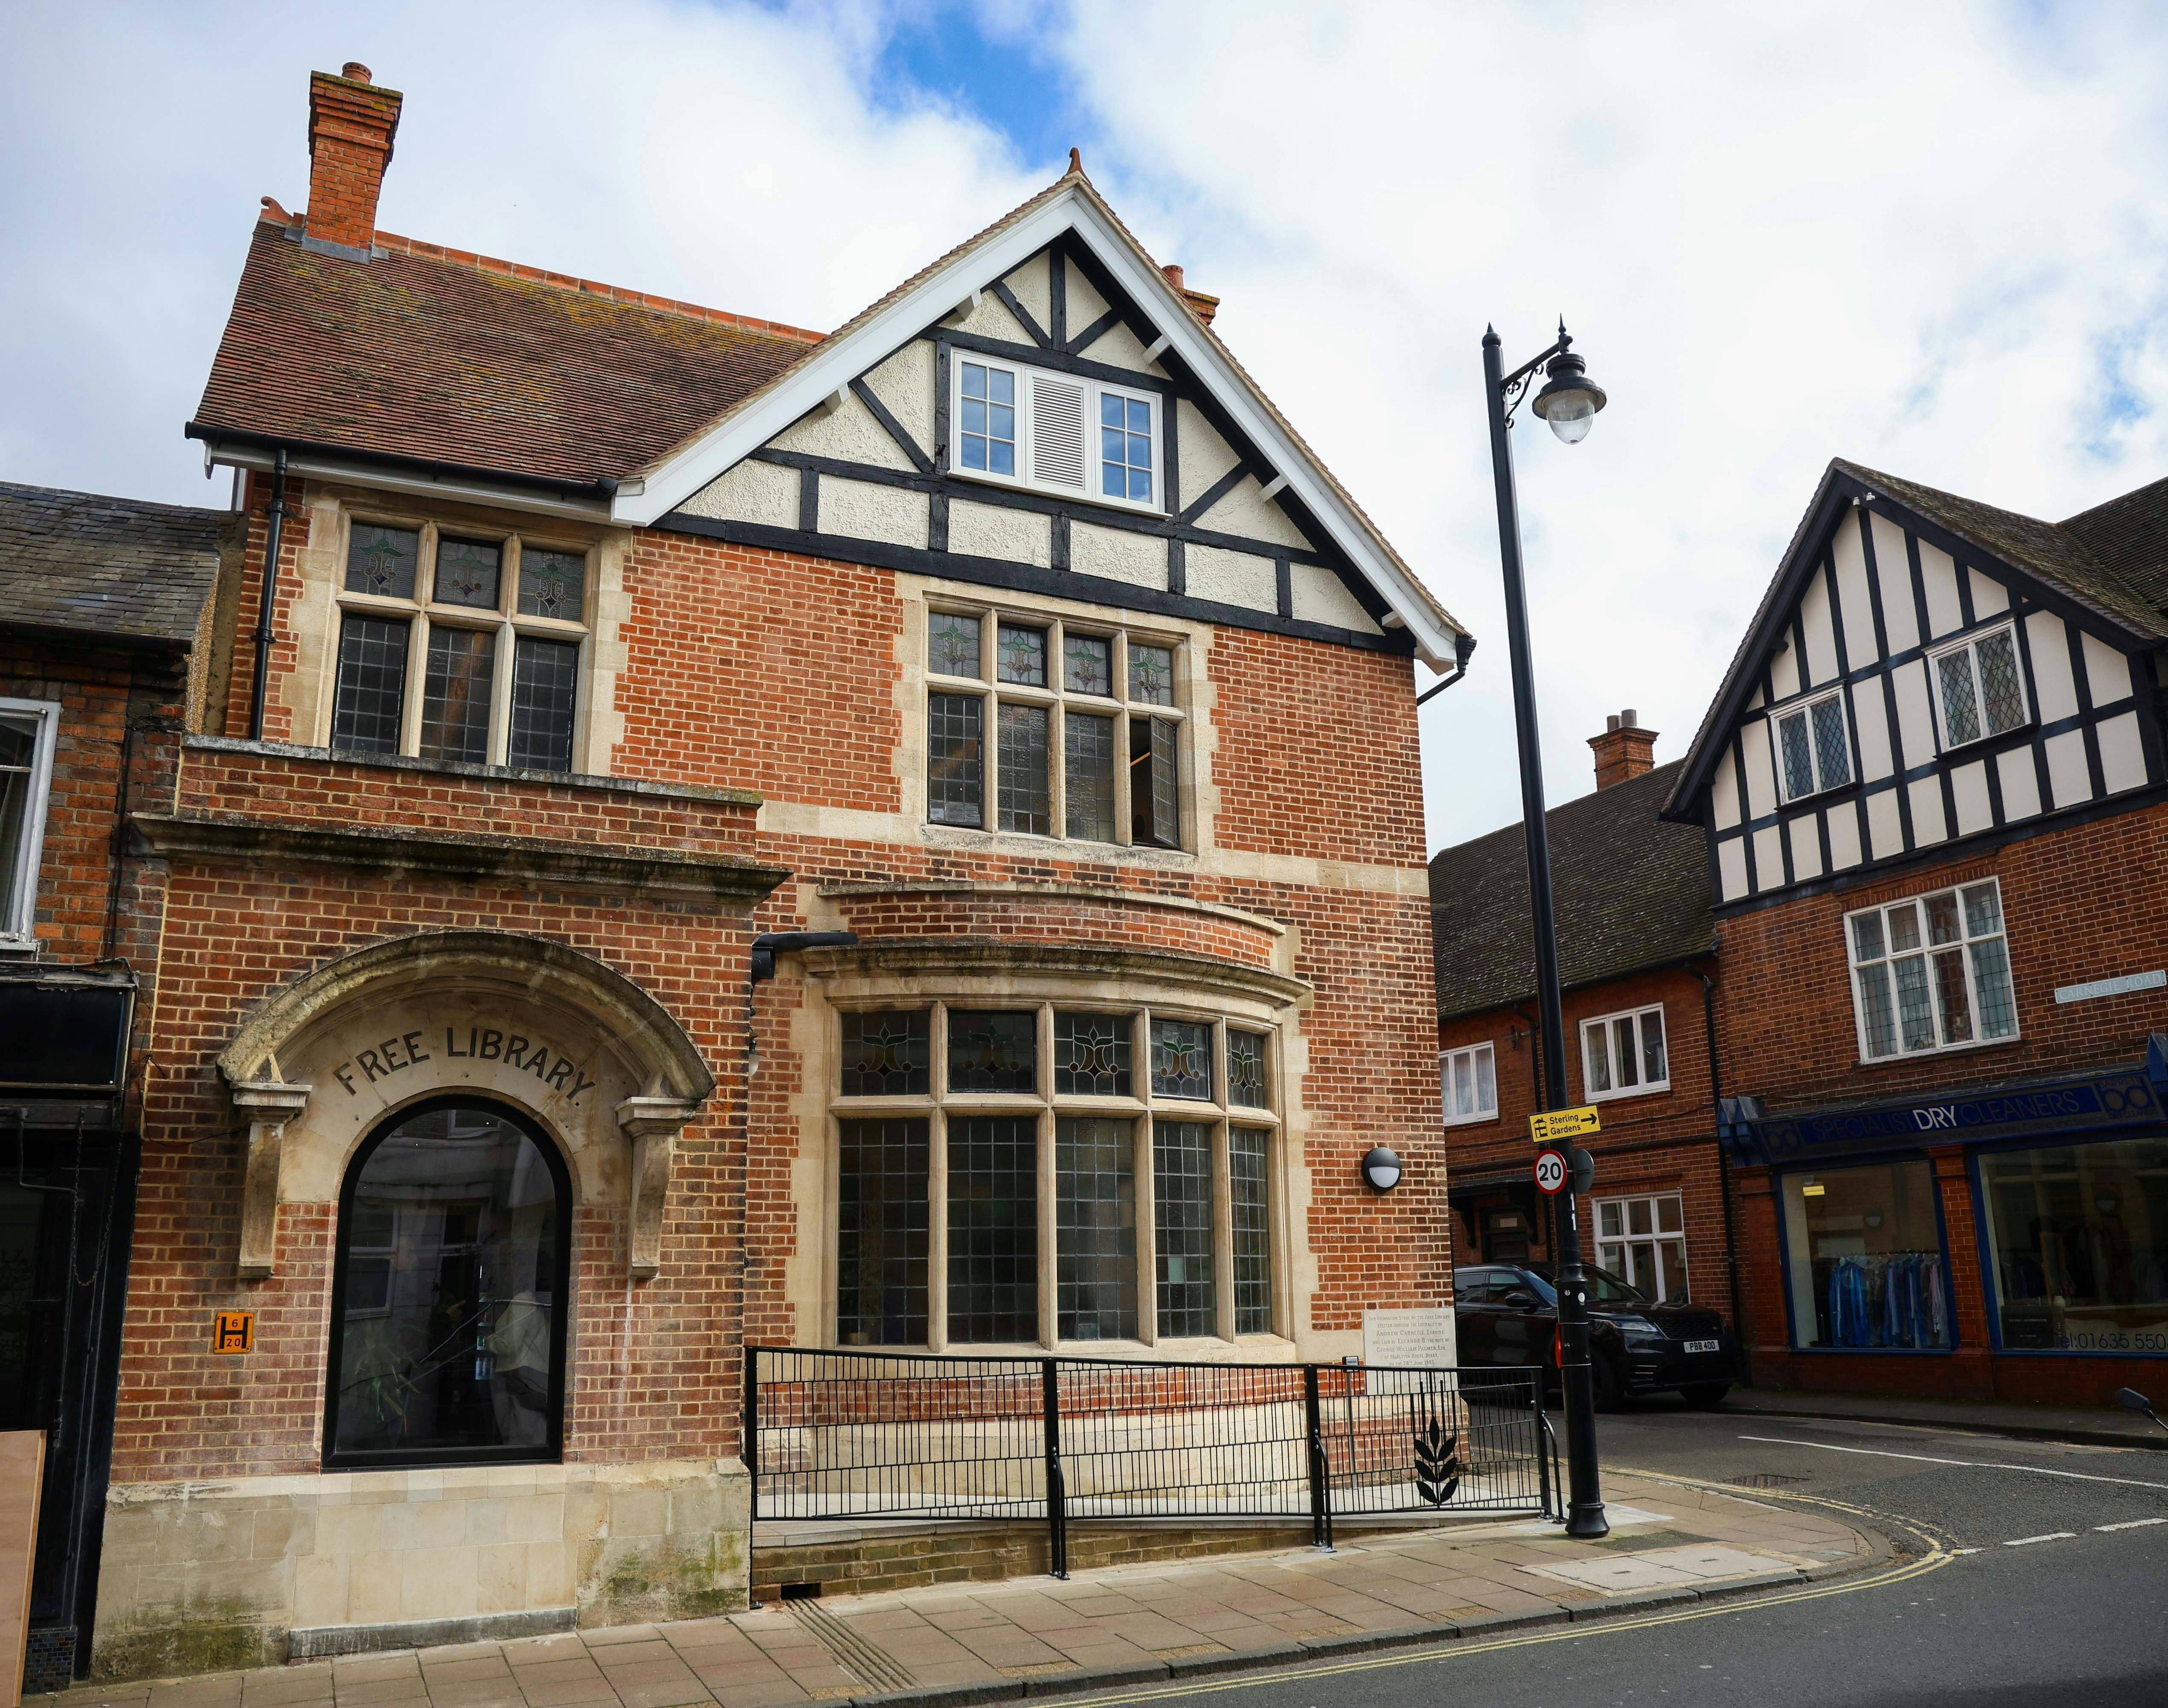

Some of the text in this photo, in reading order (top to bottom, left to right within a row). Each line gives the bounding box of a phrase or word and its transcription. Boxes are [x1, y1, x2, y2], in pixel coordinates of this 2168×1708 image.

[2059, 974, 2162, 1000] CARNEGIE ROAD
[333, 1027, 596, 1100] FREE LIBRARY
[1549, 1114, 1579, 1125] Sterling
[1812, 1091, 2080, 1141] SPECIALIST DRY CLEANERS
[1551, 1124, 1581, 1135] Gardens
[1538, 1162, 1561, 1182] 20
[232, 1319, 238, 1327] 6
[219, 1316, 248, 1349] H
[226, 1338, 240, 1347] 20
[1689, 1341, 1715, 1351] PBB 400
[2135, 1333, 2168, 1350] 550
